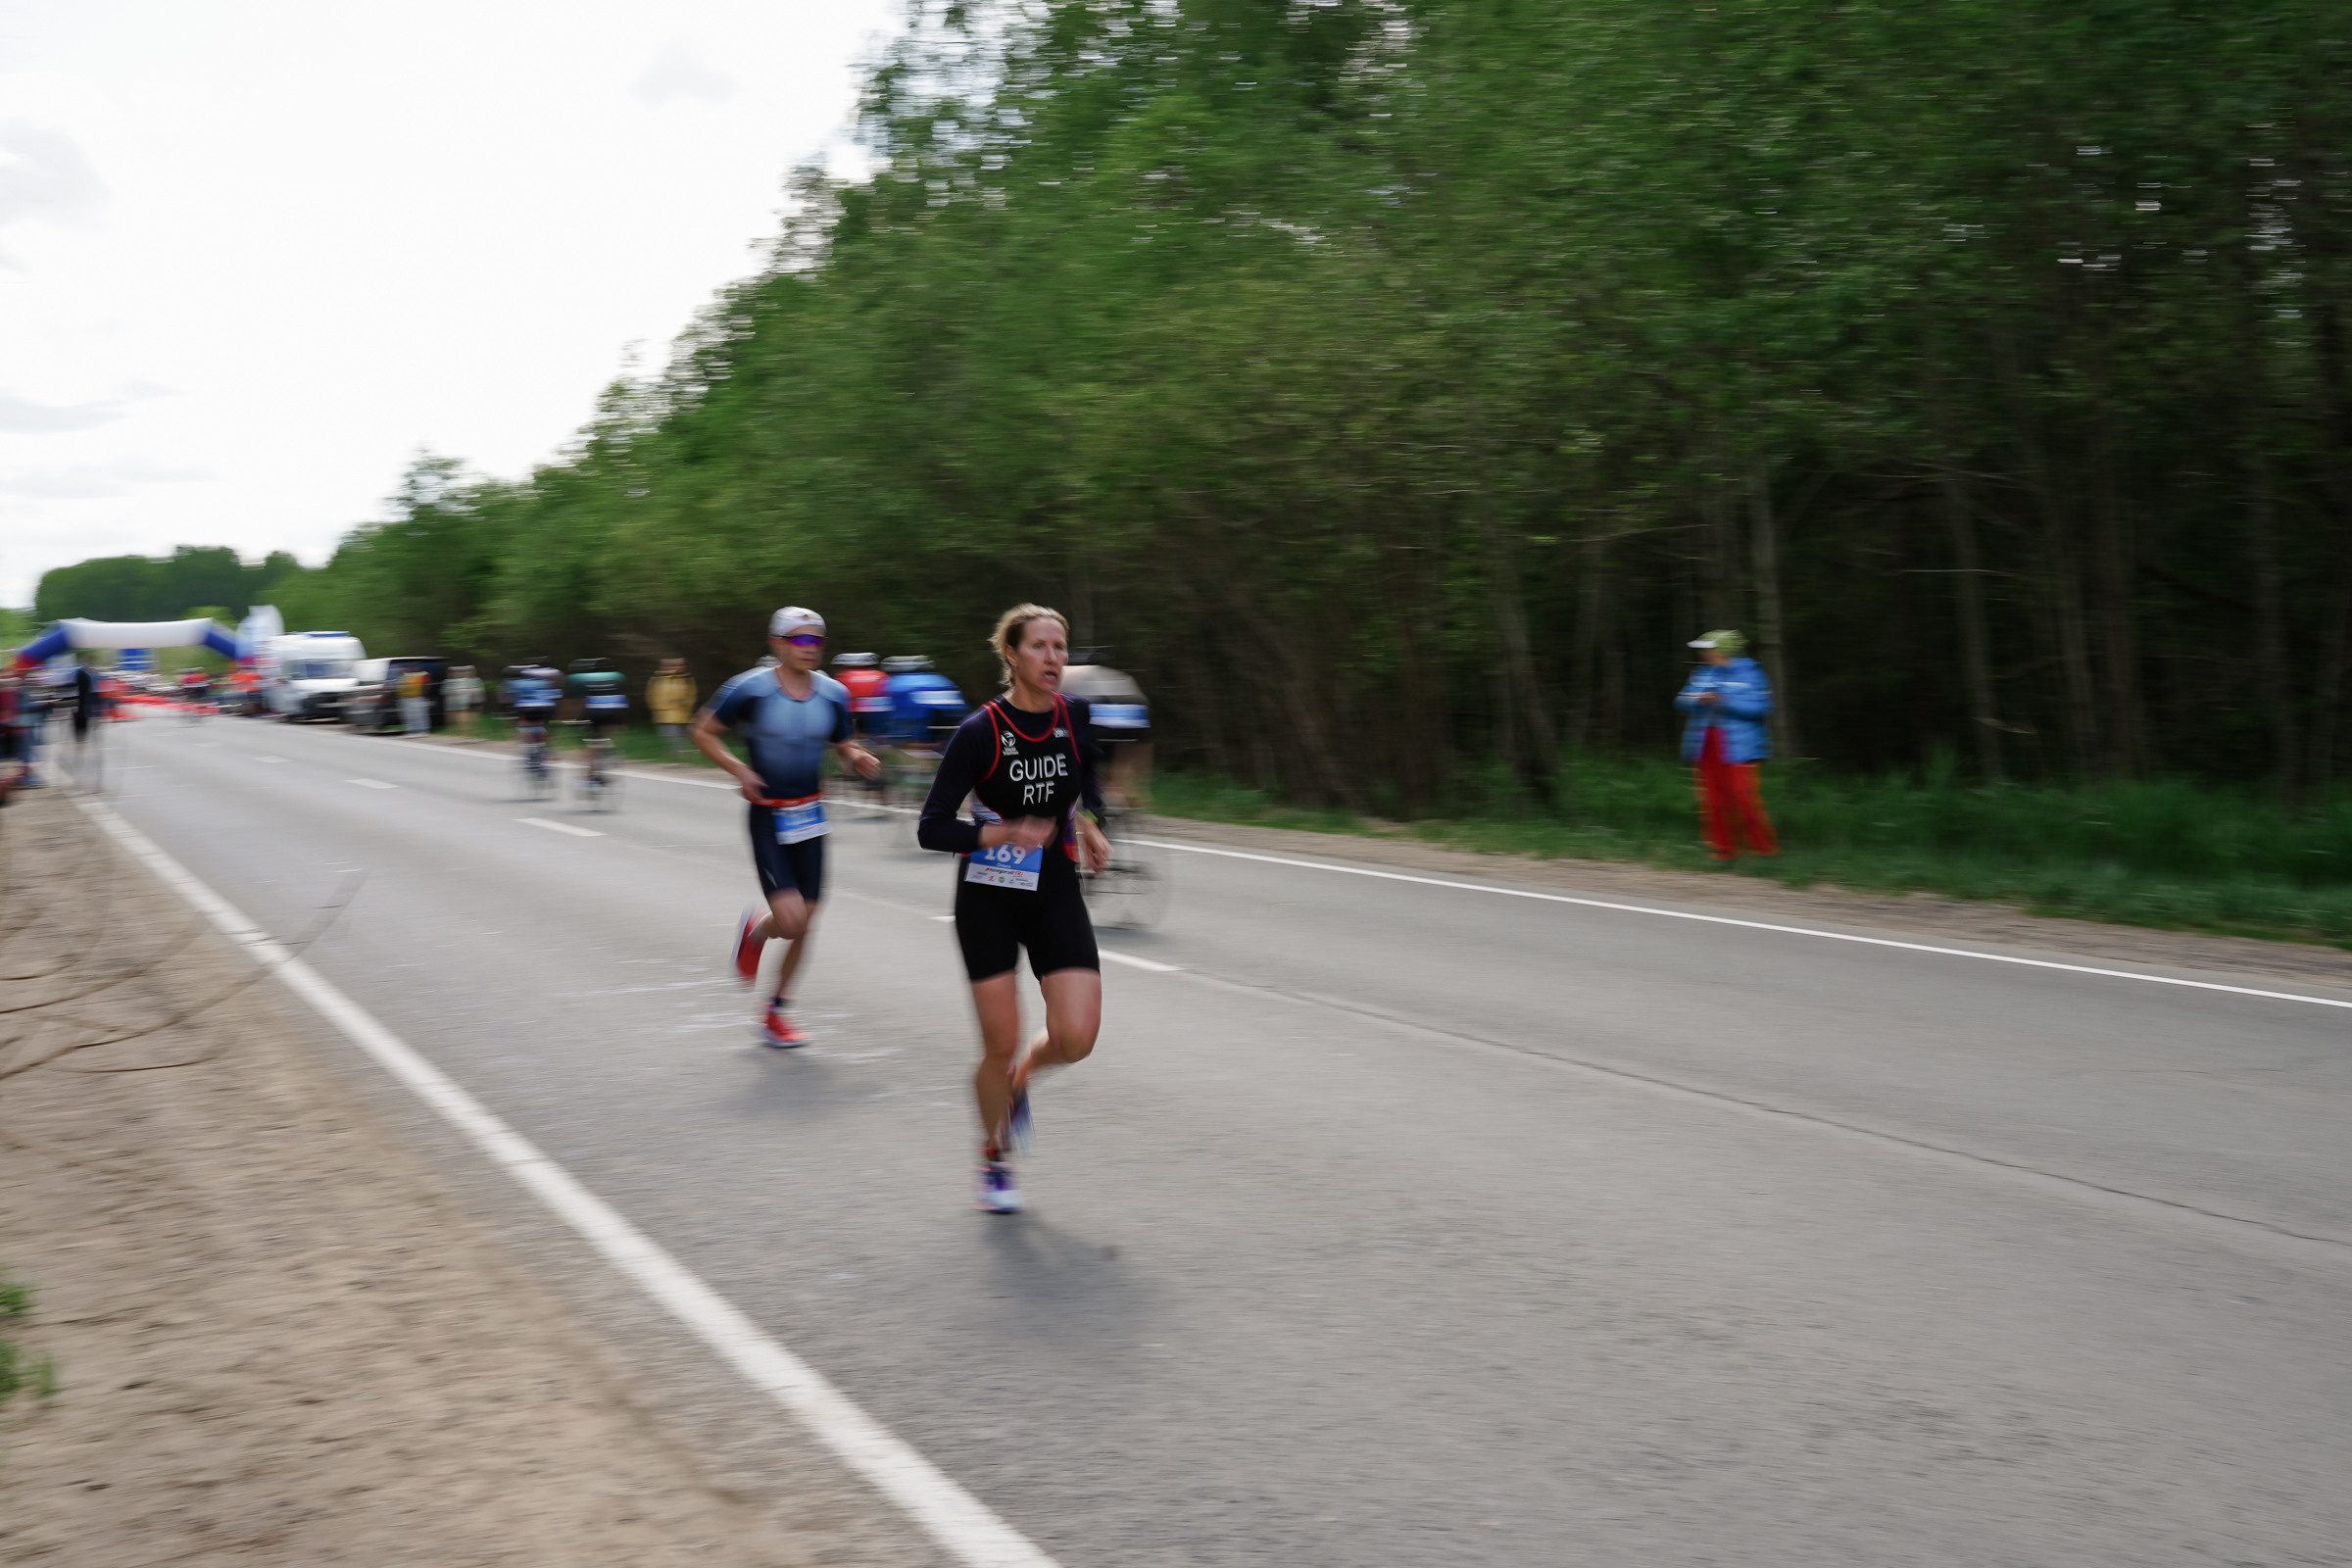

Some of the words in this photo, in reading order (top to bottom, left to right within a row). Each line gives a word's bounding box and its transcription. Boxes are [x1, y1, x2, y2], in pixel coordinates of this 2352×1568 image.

[1009, 753, 1068, 782] GUIDE
[1023, 780, 1054, 806] RTF
[984, 844, 1026, 864] 169
